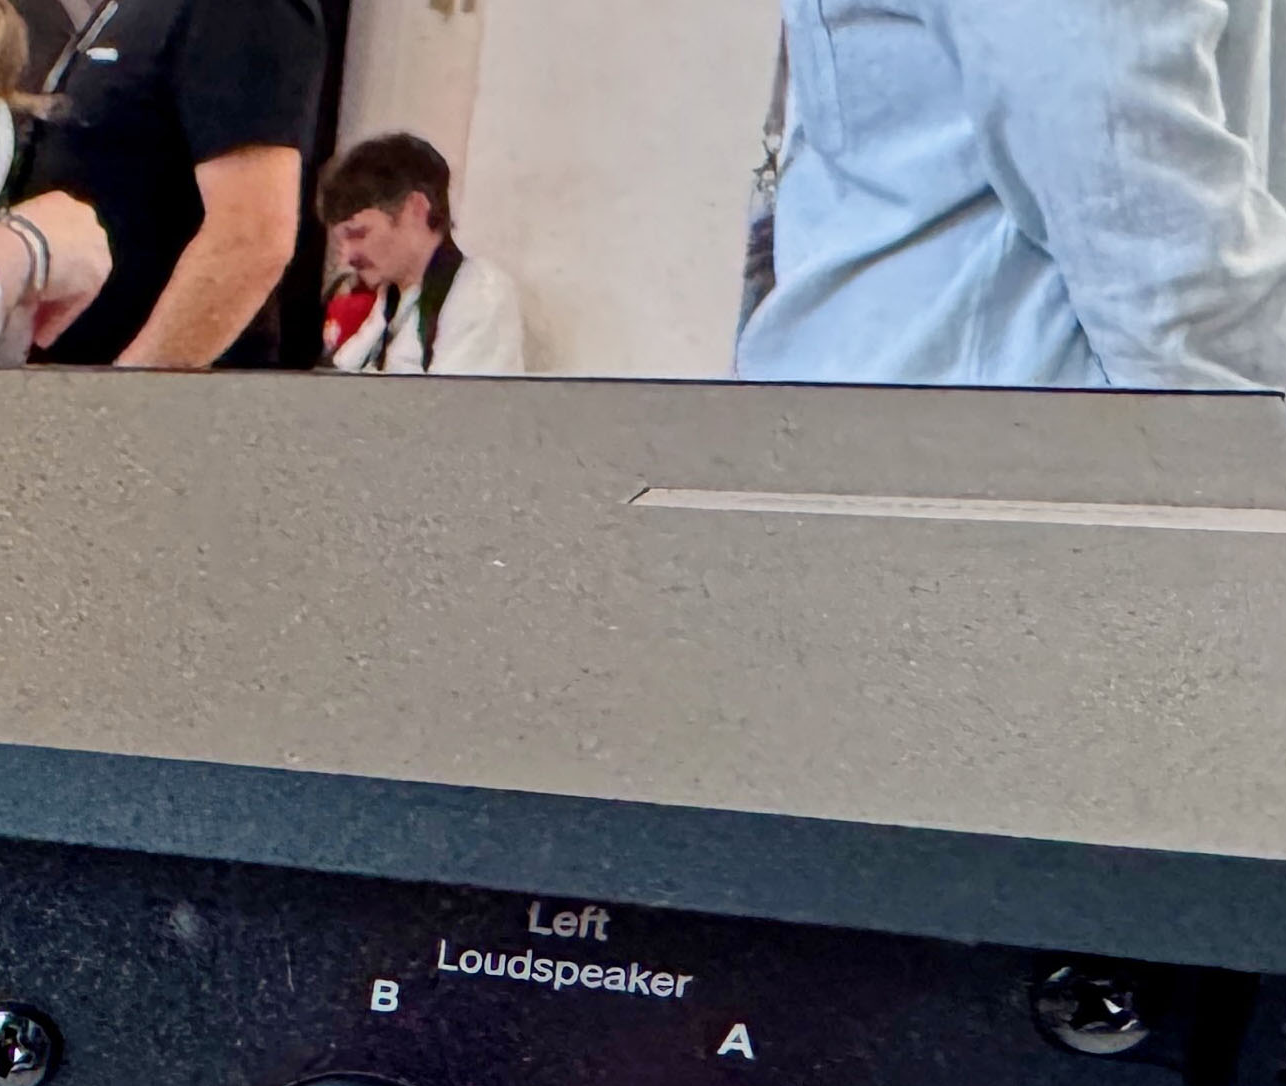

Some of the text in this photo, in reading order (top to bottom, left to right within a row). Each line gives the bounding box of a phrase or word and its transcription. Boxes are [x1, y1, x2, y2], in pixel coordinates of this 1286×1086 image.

[528, 901, 610, 941] Left
[438, 938, 694, 999] Loudspeaker
[370, 978, 400, 1013] B
[716, 1023, 756, 1060] A
